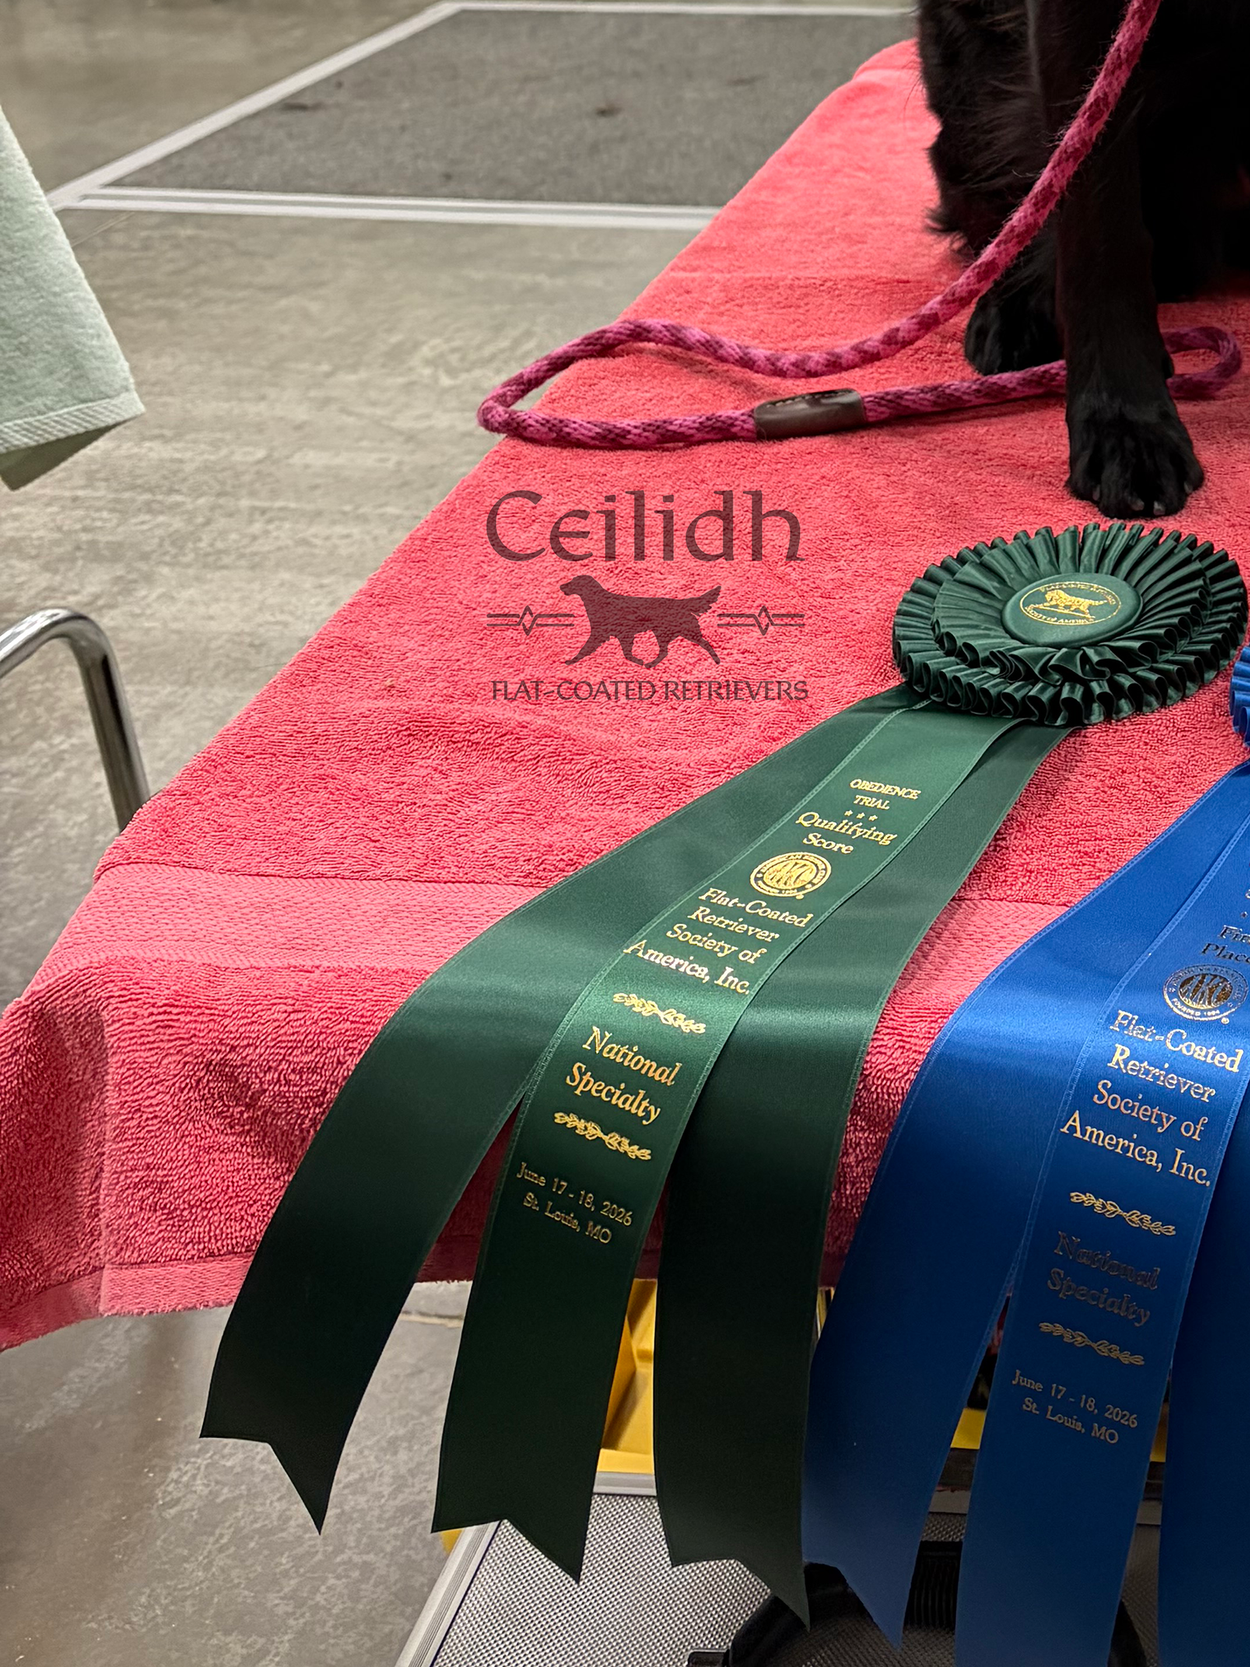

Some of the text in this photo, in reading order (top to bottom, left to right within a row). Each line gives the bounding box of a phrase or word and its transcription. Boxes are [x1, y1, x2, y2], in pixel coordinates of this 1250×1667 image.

[850, 778, 922, 800] OBEDIENCE
[853, 794, 890, 810] TRIAL
[795, 811, 898, 846] Qualifying
[802, 832, 854, 854] Score
[687, 905, 780, 943] Retriever
[698, 887, 814, 928] Flat-Coated
[623, 938, 751, 996] America, Inc.
[666, 923, 767, 964] Society of
[582, 1024, 683, 1087] National
[1109, 1009, 1244, 1073] Flat-Coated
[565, 1061, 662, 1125] Specialty
[1107, 1043, 1216, 1103] Retriever
[1092, 1079, 1208, 1142] Society of
[1059, 1109, 1211, 1187] America, Inc.
[516, 1161, 546, 1187] June
[551, 1177, 568, 1196] 17
[578, 1189, 595, 1212] 18,
[600, 1201, 633, 1227] 2026
[522, 1191, 612, 1245] St. Louis, MO
[1053, 1230, 1161, 1291] National
[1046, 1266, 1151, 1328] Specialty
[1011, 1369, 1044, 1392] June
[1050, 1383, 1067, 1400] 17
[1079, 1394, 1098, 1415] 18,
[1103, 1404, 1138, 1429] 2026
[1022, 1396, 1119, 1444] St. Louis, MO
